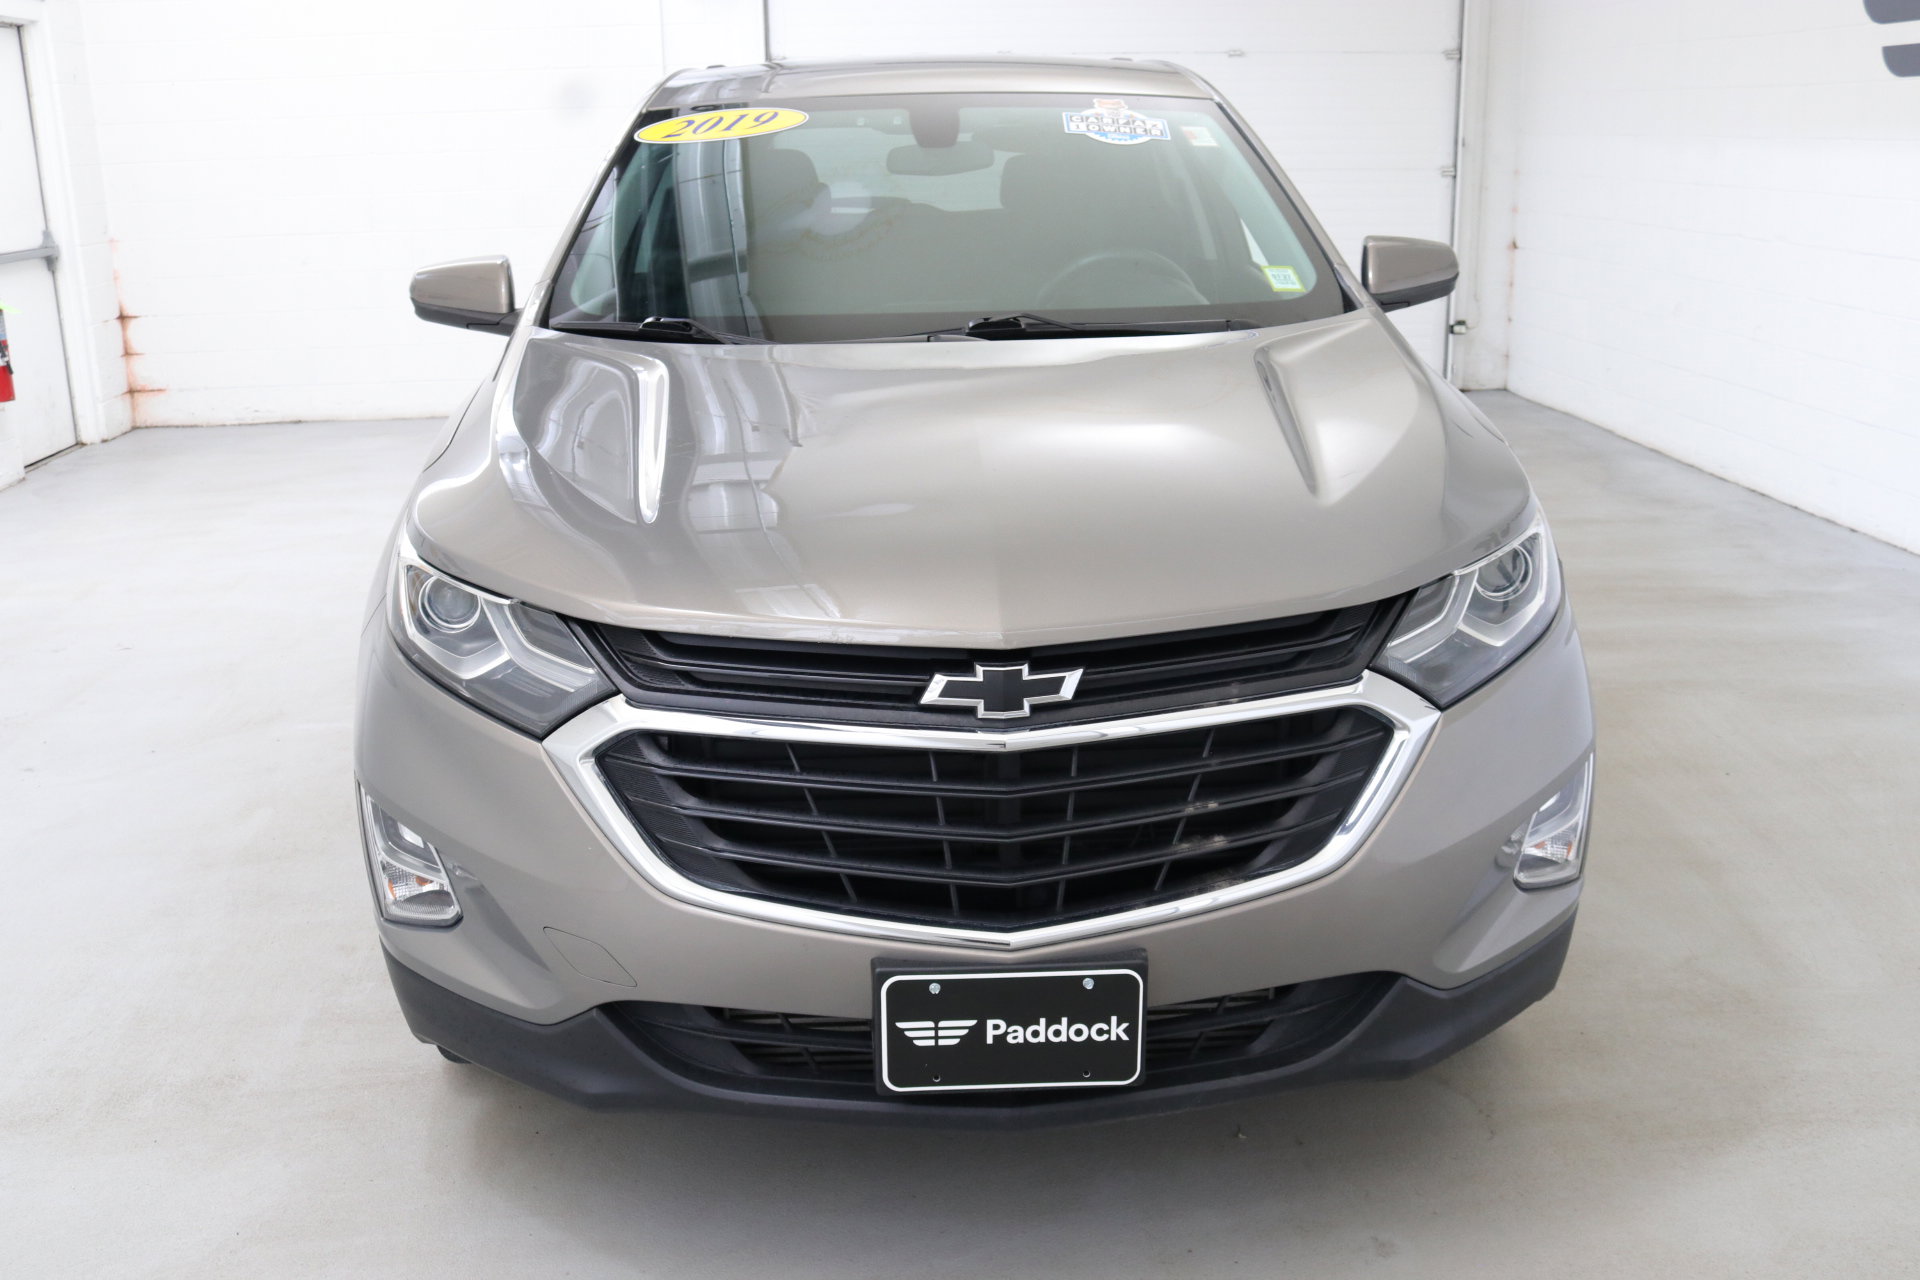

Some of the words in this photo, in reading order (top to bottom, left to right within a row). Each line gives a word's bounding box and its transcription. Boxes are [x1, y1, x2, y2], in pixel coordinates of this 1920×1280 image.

[661, 111, 779, 139] 2019
[1089, 124, 1162, 136] OWNER
[986, 1015, 1130, 1045] Paddock
